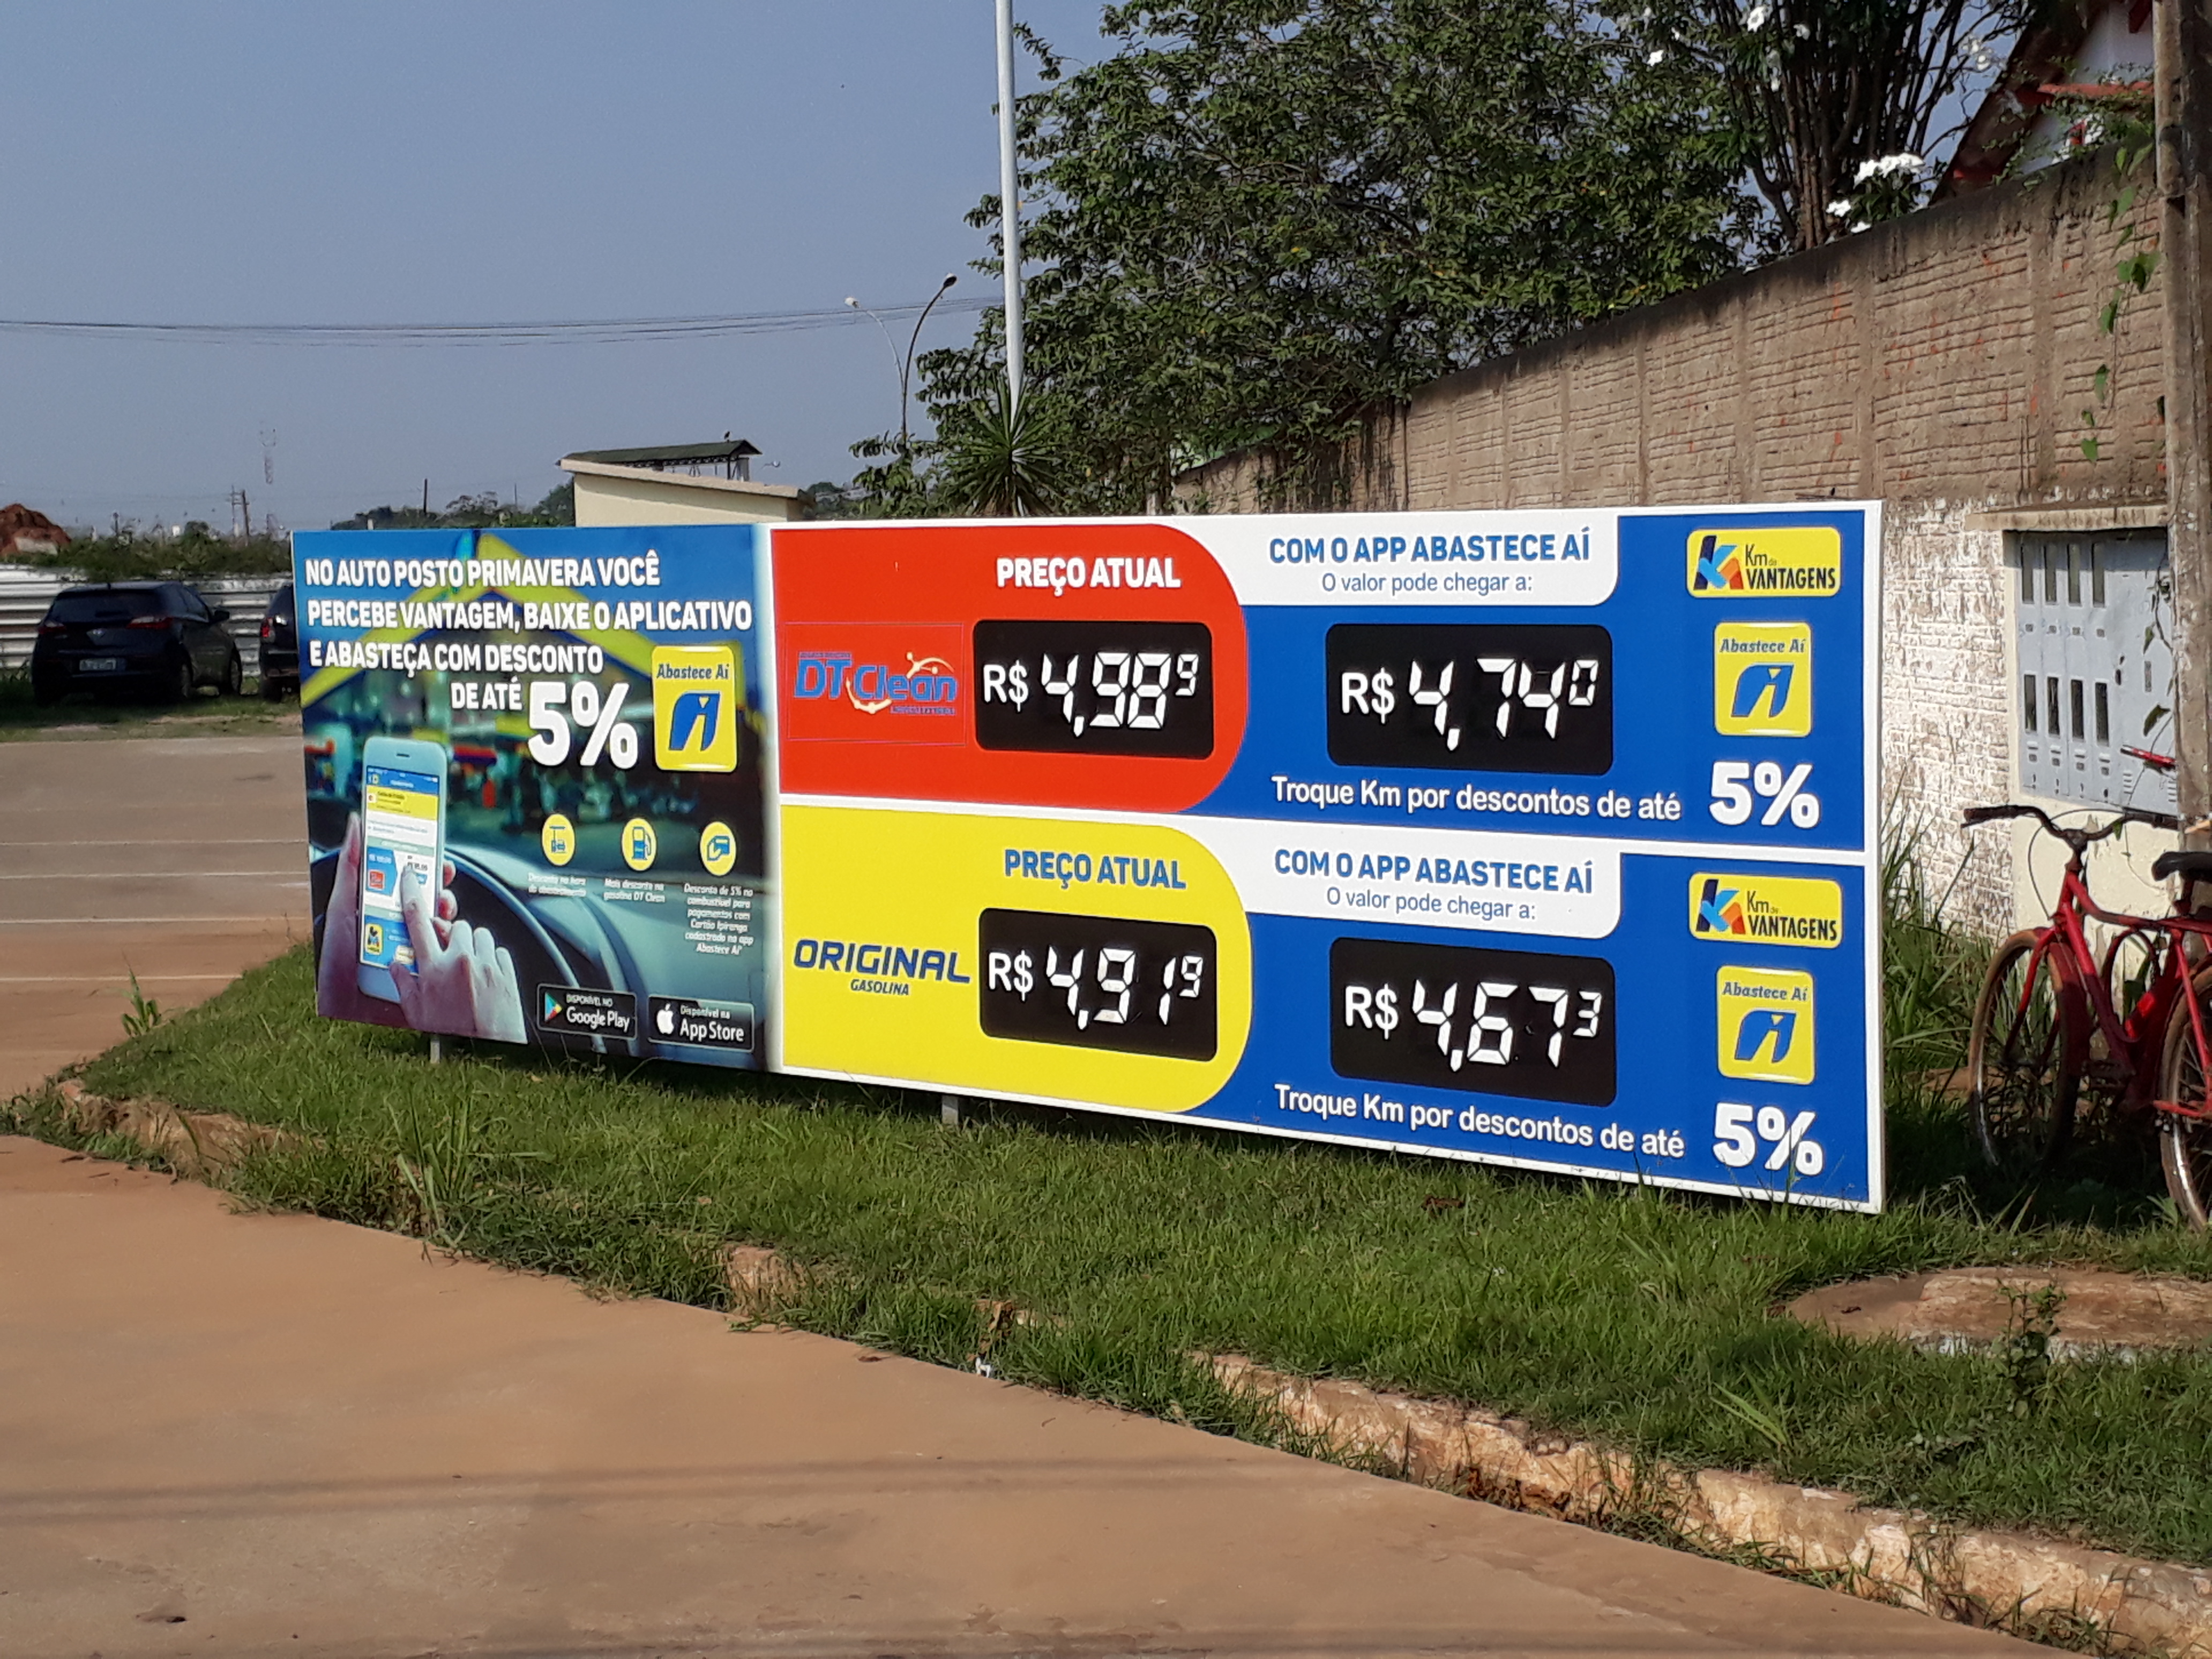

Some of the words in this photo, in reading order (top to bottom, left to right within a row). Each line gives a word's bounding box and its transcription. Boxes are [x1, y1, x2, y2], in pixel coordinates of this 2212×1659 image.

[1269, 537, 1325, 563] COM
[1331, 537, 1348, 563] O
[1354, 536, 1407, 563] APP
[1411, 534, 1556, 562] ABASTECE
[1561, 527, 1590, 560] AÍ
[1745, 544, 1767, 566] Km
[306, 558, 331, 586] NO
[337, 559, 391, 587] AUTO
[394, 560, 463, 587] POSTO
[467, 558, 595, 587] PRIMAVERA
[600, 550, 660, 586] VOCÊ
[997, 557, 1085, 596] PREÇO
[1090, 557, 1182, 588] ATUAL
[1322, 573, 1334, 591] O
[1341, 573, 1386, 591] valor
[1392, 573, 1438, 596] pode
[1443, 572, 1509, 596] chegar
[1515, 575, 1533, 591] a:
[1746, 567, 1835, 589] VANTAGENS
[308, 600, 398, 628] PERCEBE
[400, 601, 520, 634] VANTAGEM,
[524, 602, 589, 630] BAIXE
[594, 603, 610, 630] O
[614, 601, 751, 631] APLICATIVO
[309, 640, 322, 667] E
[324, 642, 432, 679] ABASTEÇA
[435, 645, 482, 672] COM
[487, 645, 603, 674] DESCONTO
[1720, 638, 1785, 653] Abastece
[656, 663, 712, 679] Abastece
[794, 659, 852, 699] DT
[854, 665, 958, 701] Clean
[983, 660, 1028, 712] R$
[1341, 668, 1394, 723] R$
[451, 684, 480, 709] DE
[482, 676, 522, 710] ATÉ
[528, 681, 638, 769] 5%
[1272, 776, 1354, 809] Troque
[1361, 780, 1401, 807] Km
[1408, 786, 1447, 813] por
[1456, 784, 1590, 817] descontos
[1597, 790, 1631, 818] de
[1639, 793, 1681, 820] até
[1709, 761, 1820, 828] 5%
[1005, 849, 1092, 888] PREÇO
[1097, 855, 1186, 890] ATUAL
[1275, 849, 1329, 877] COM
[1336, 852, 1353, 878] O
[1358, 855, 1412, 882] APP
[1416, 857, 1559, 891] ABASTECE
[1565, 861, 1593, 893] AÍ
[633, 892, 644, 901] DT
[684, 883, 718, 894] Desconto
[719, 885, 728, 895] de
[730, 886, 742, 895] 5%
[1327, 887, 1340, 905] O
[1346, 890, 1391, 908] valor
[1395, 892, 1442, 916] pode
[1447, 896, 1512, 921] chegar
[1518, 904, 1536, 920] a:
[1747, 891, 1769, 913] Km
[1748, 915, 1837, 941] VANTAGENS
[794, 939, 970, 984] ORIGINAL
[988, 950, 1033, 1002] R$
[602, 998, 613, 1007] NO
[851, 979, 909, 995] GASOLINA
[1722, 982, 1787, 1000] Abastece
[566, 1006, 606, 1029] Google
[607, 1011, 630, 1033] Play
[1344, 983, 1399, 1040] R$
[679, 1018, 707, 1041] App
[708, 1021, 744, 1042] Store
[1275, 1083, 1357, 1120] Troque
[1363, 1093, 1403, 1122] Km
[1410, 1105, 1453, 1130] por
[1459, 1105, 1593, 1147] descontos
[1600, 1122, 1634, 1149] de
[1641, 1129, 1685, 1157] até
[1713, 1102, 1823, 1176] 5%
